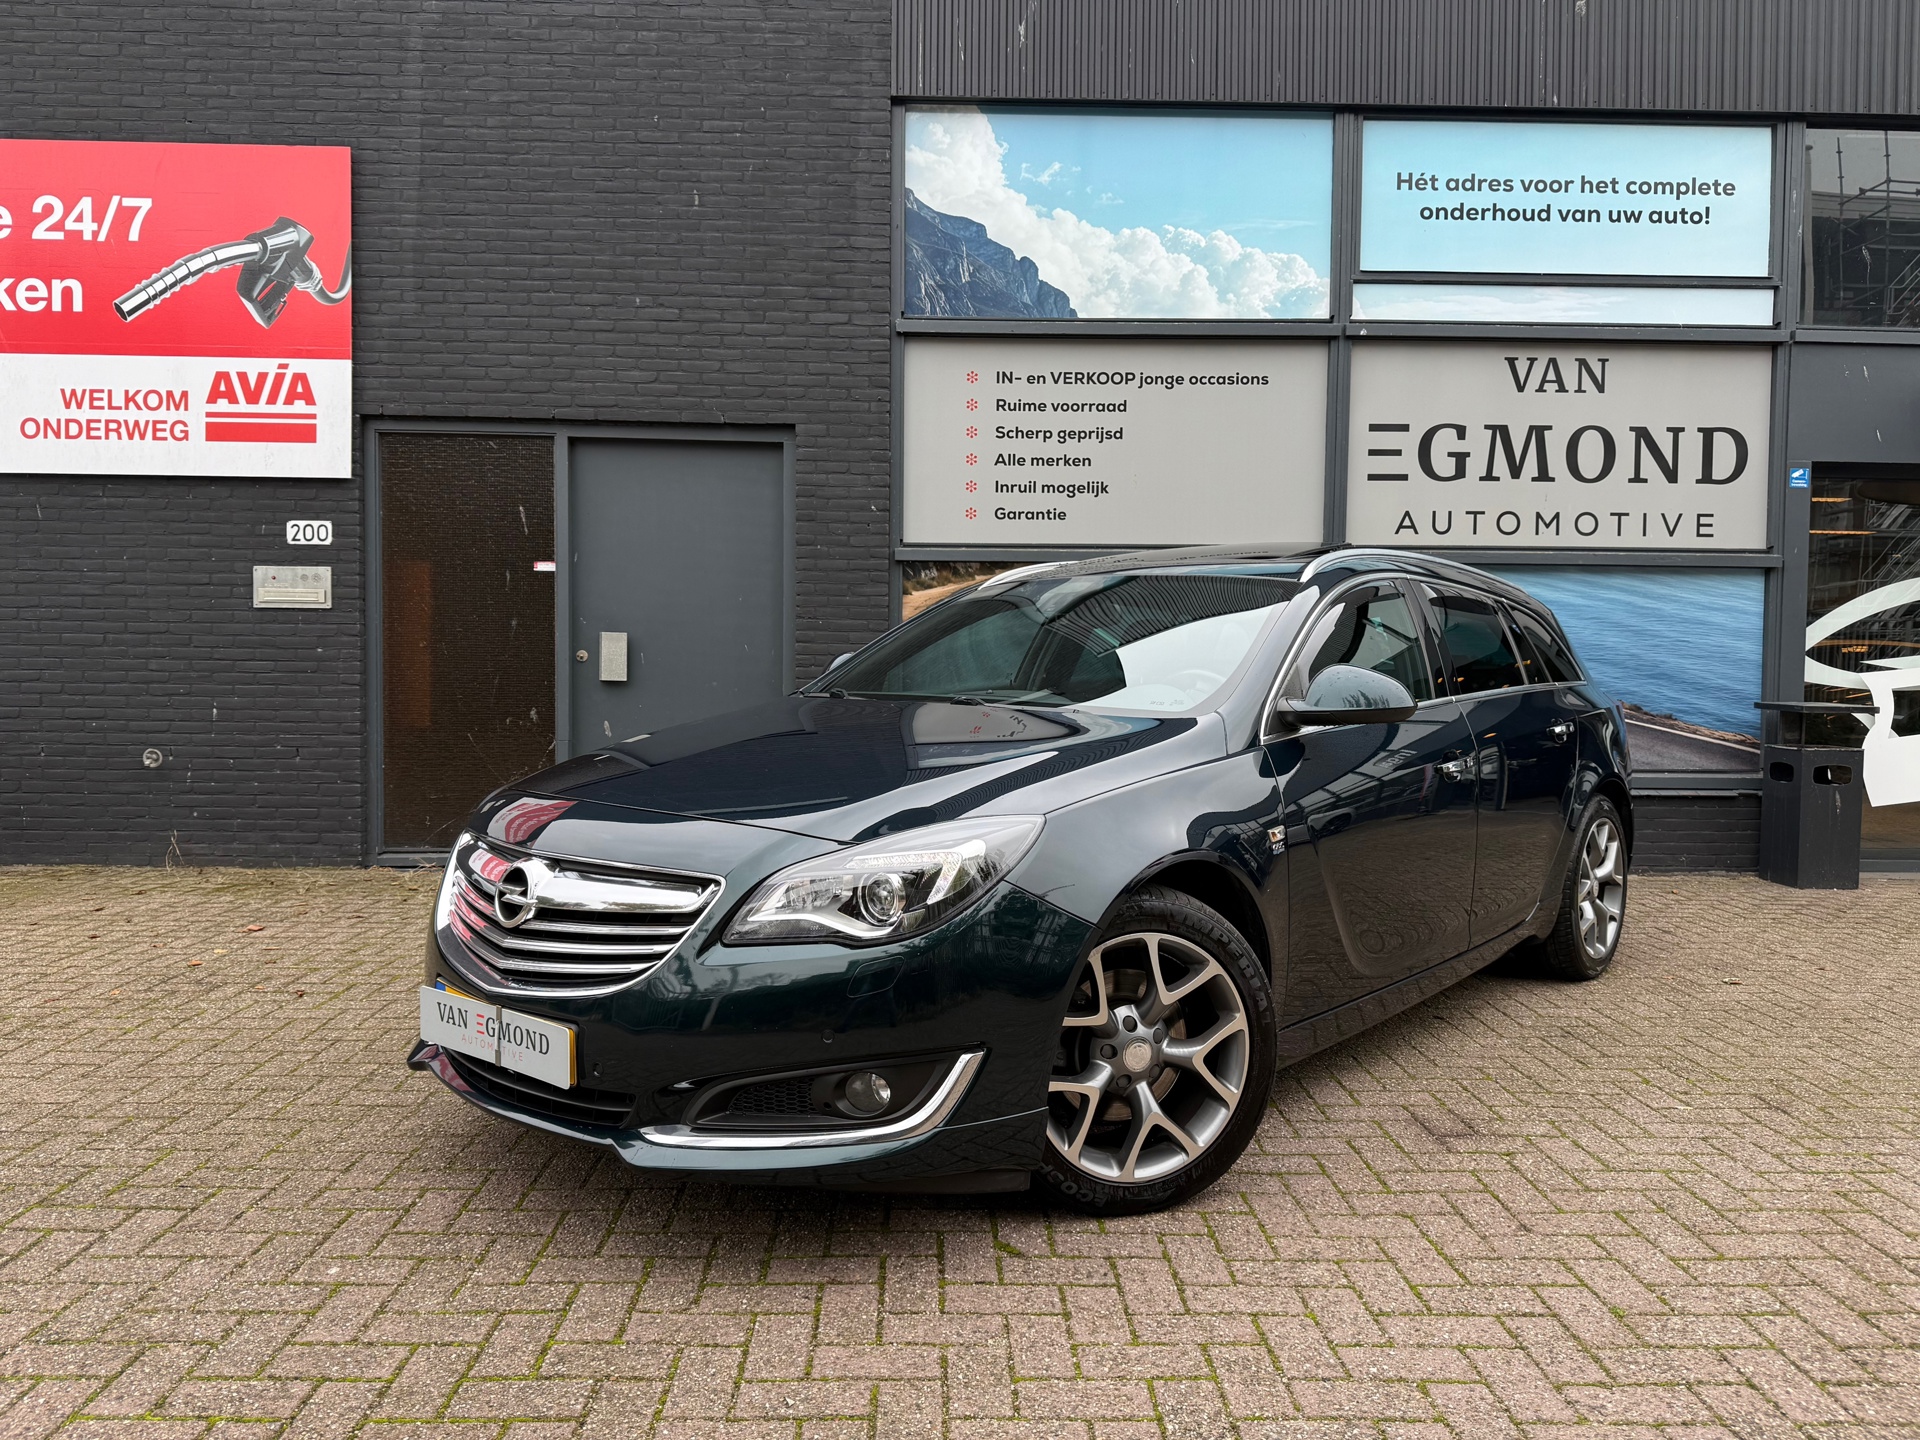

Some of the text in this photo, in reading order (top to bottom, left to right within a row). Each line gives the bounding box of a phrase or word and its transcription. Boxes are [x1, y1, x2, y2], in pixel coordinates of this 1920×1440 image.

[1396, 171, 1736, 200] Hét adres voor het complete
[32, 195, 153, 242] 24/7
[1419, 202, 1711, 225] onderhoud van uw auto!
[205, 363, 318, 406] AVIA
[996, 371, 1269, 390] IN- en VERKOOP jonge occasions
[1504, 356, 1610, 394] VAN
[60, 388, 189, 412] WELKOM
[996, 398, 1127, 413] Ruime voorraad
[20, 417, 189, 441] ONDERWEG
[995, 425, 1124, 444] Scherp geprijsd
[994, 453, 1092, 467] Alle merken
[1366, 422, 1749, 486] EGMOND
[995, 480, 1109, 498] Inruil mogelijk
[994, 507, 1067, 521] Garantie
[1394, 510, 1715, 538] AUTOMOTIVE
[290, 523, 329, 542] 200
[437, 1002, 468, 1029] VAN
[461, 1033, 524, 1062] AUTOMTIVE
